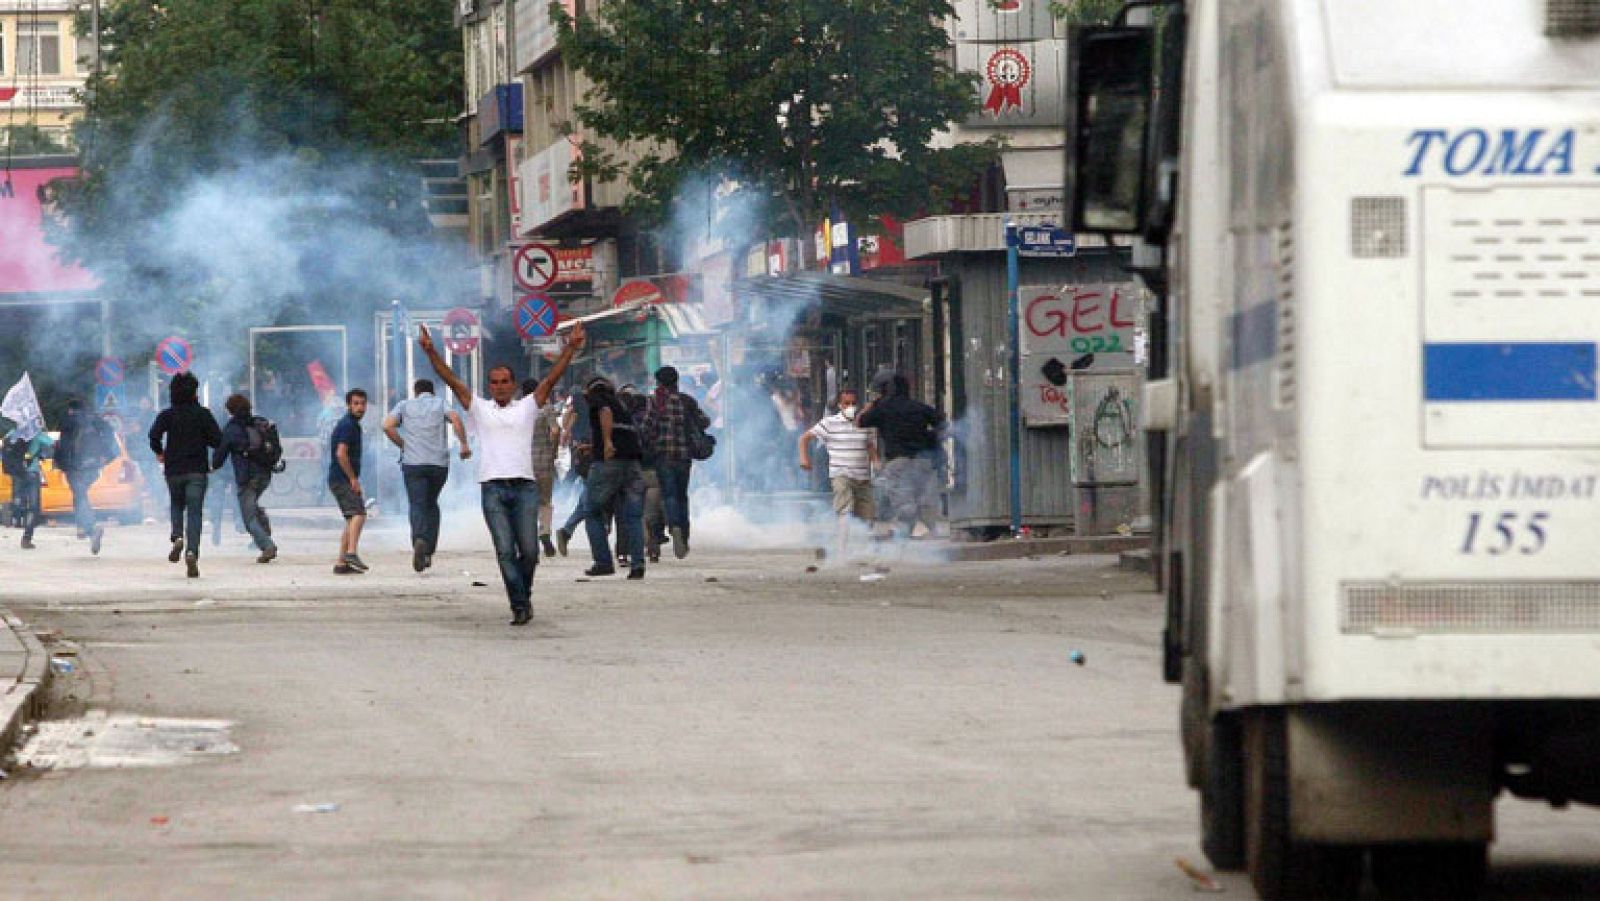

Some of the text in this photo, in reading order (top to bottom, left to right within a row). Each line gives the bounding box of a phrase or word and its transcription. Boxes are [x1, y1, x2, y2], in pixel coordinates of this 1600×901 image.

[1403, 129, 1575, 175] TOMA
[1026, 290, 1134, 337] GEL
[1462, 511, 1551, 556] 155
